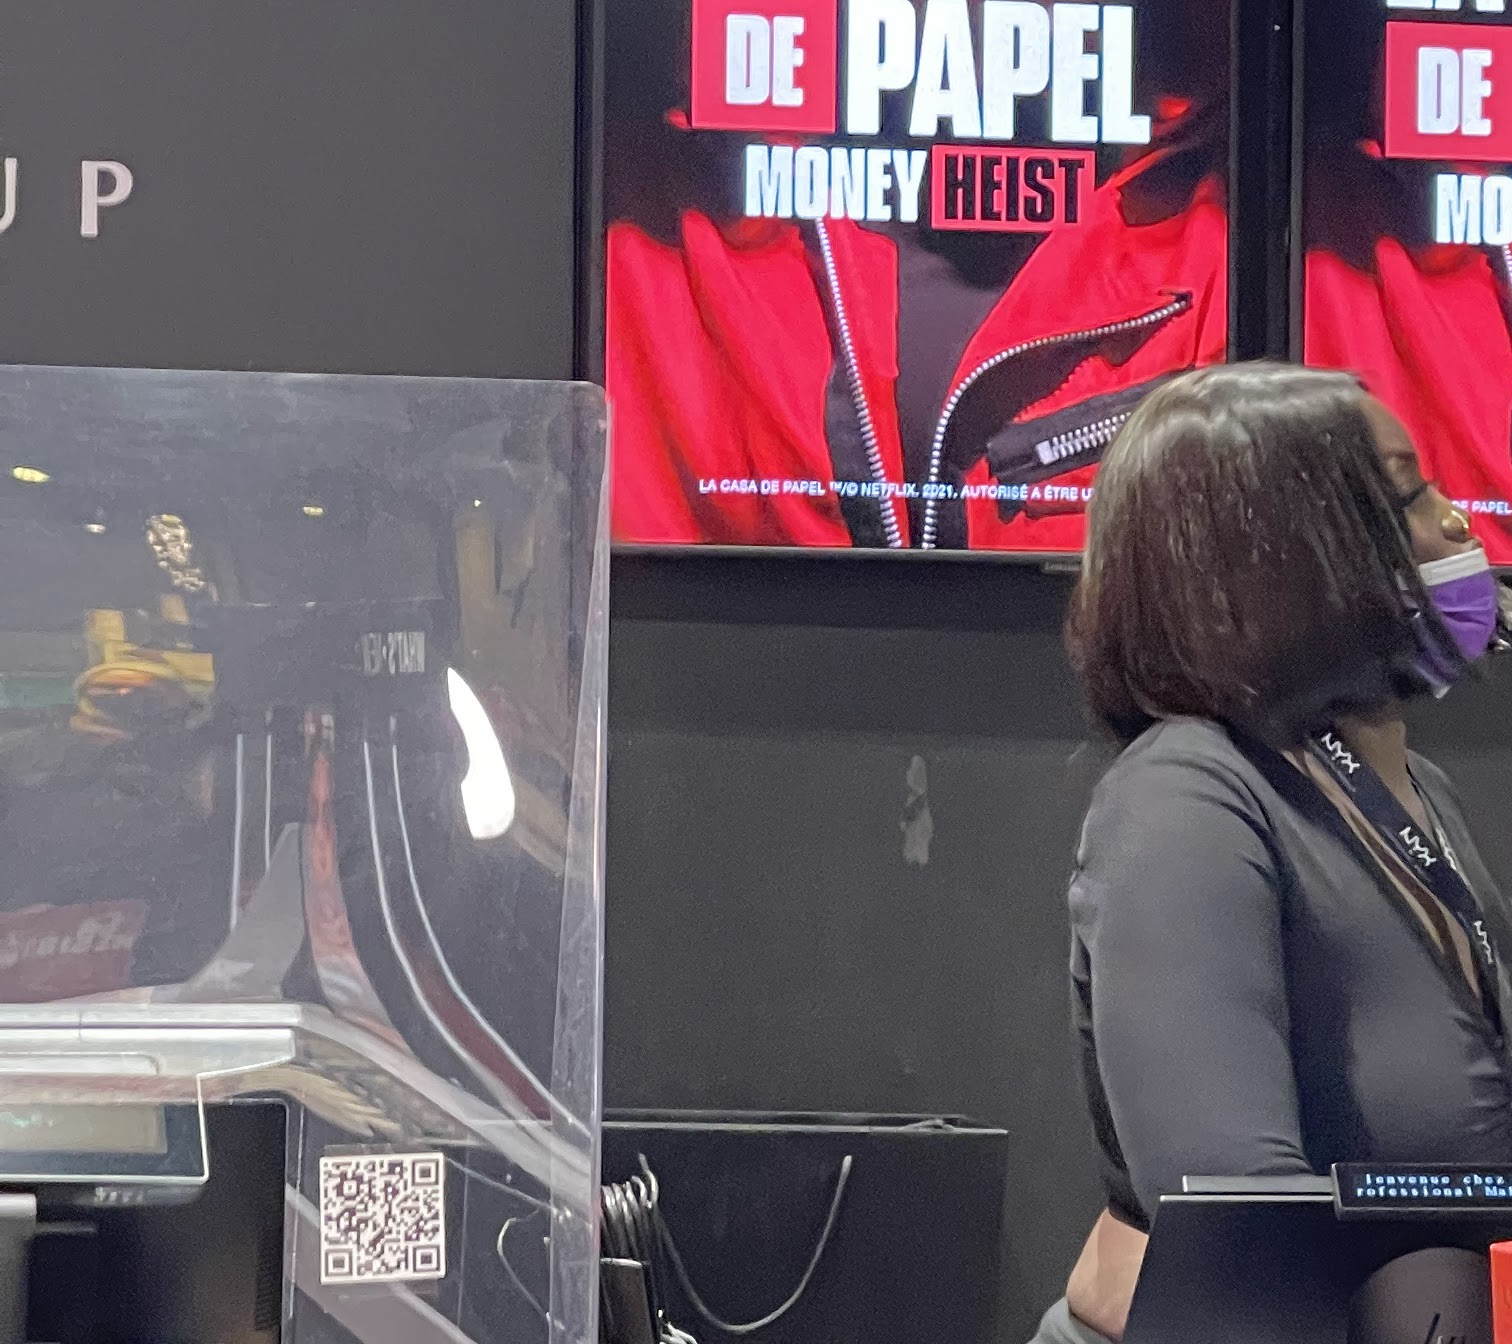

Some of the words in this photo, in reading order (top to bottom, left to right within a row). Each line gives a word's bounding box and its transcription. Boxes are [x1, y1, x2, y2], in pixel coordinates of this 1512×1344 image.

[725, 14, 805, 107] DE
[1416, 47, 1492, 137] DE
[746, 145, 928, 223] MONEY
[943, 155, 1085, 225] HEIST
[700, 479, 716, 493] LA
[720, 480, 758, 494] CASA
[761, 481, 780, 494] DE
[783, 481, 826, 495] PAPEL
[960, 483, 1028, 500] AUTORISÉ
[1472, 500, 1512, 515] PAPEL
[1321, 732, 1360, 774] NYX
[1399, 826, 1437, 867] NYX
[1463, 1173, 1505, 1185] chez
